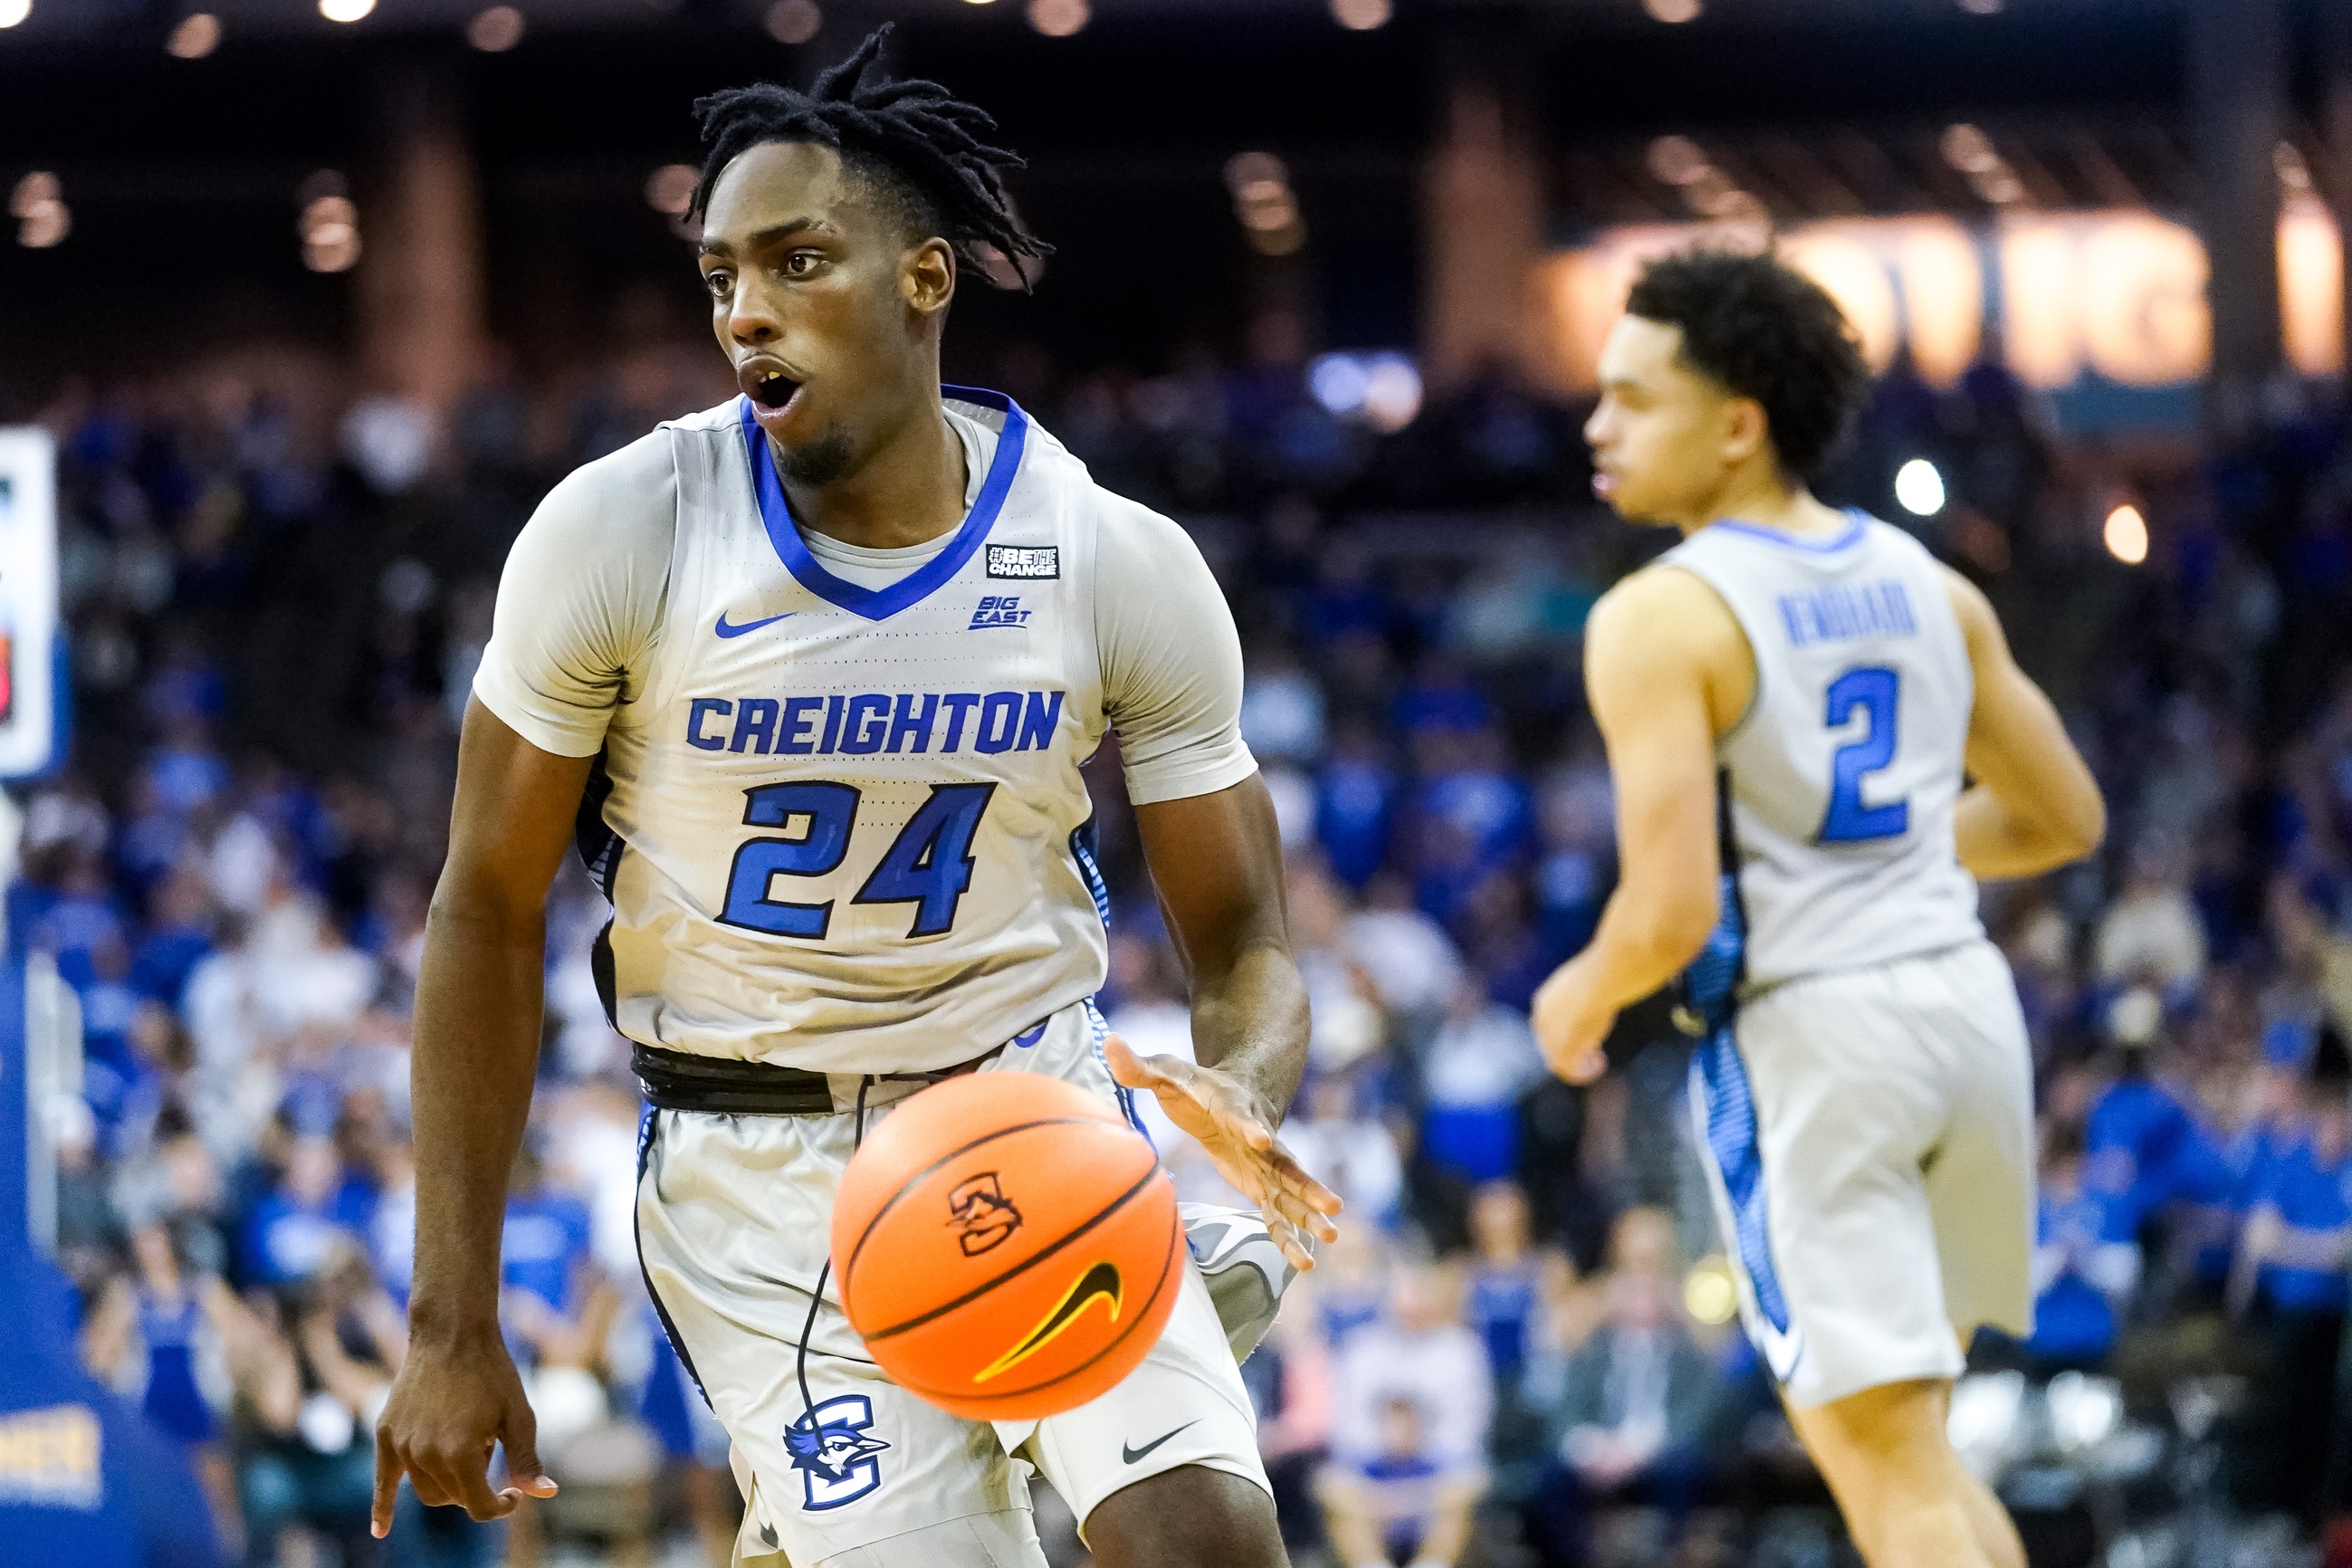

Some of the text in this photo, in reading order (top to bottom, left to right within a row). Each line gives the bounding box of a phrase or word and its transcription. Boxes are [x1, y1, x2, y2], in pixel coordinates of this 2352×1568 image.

[989, 564, 1056, 576] CHANGE
[971, 610, 1031, 624] EAST
[978, 596, 1020, 610] BIG
[685, 691, 1066, 755] CREIGHTON
[1821, 667, 1907, 841] 2
[714, 780, 999, 940] 24
